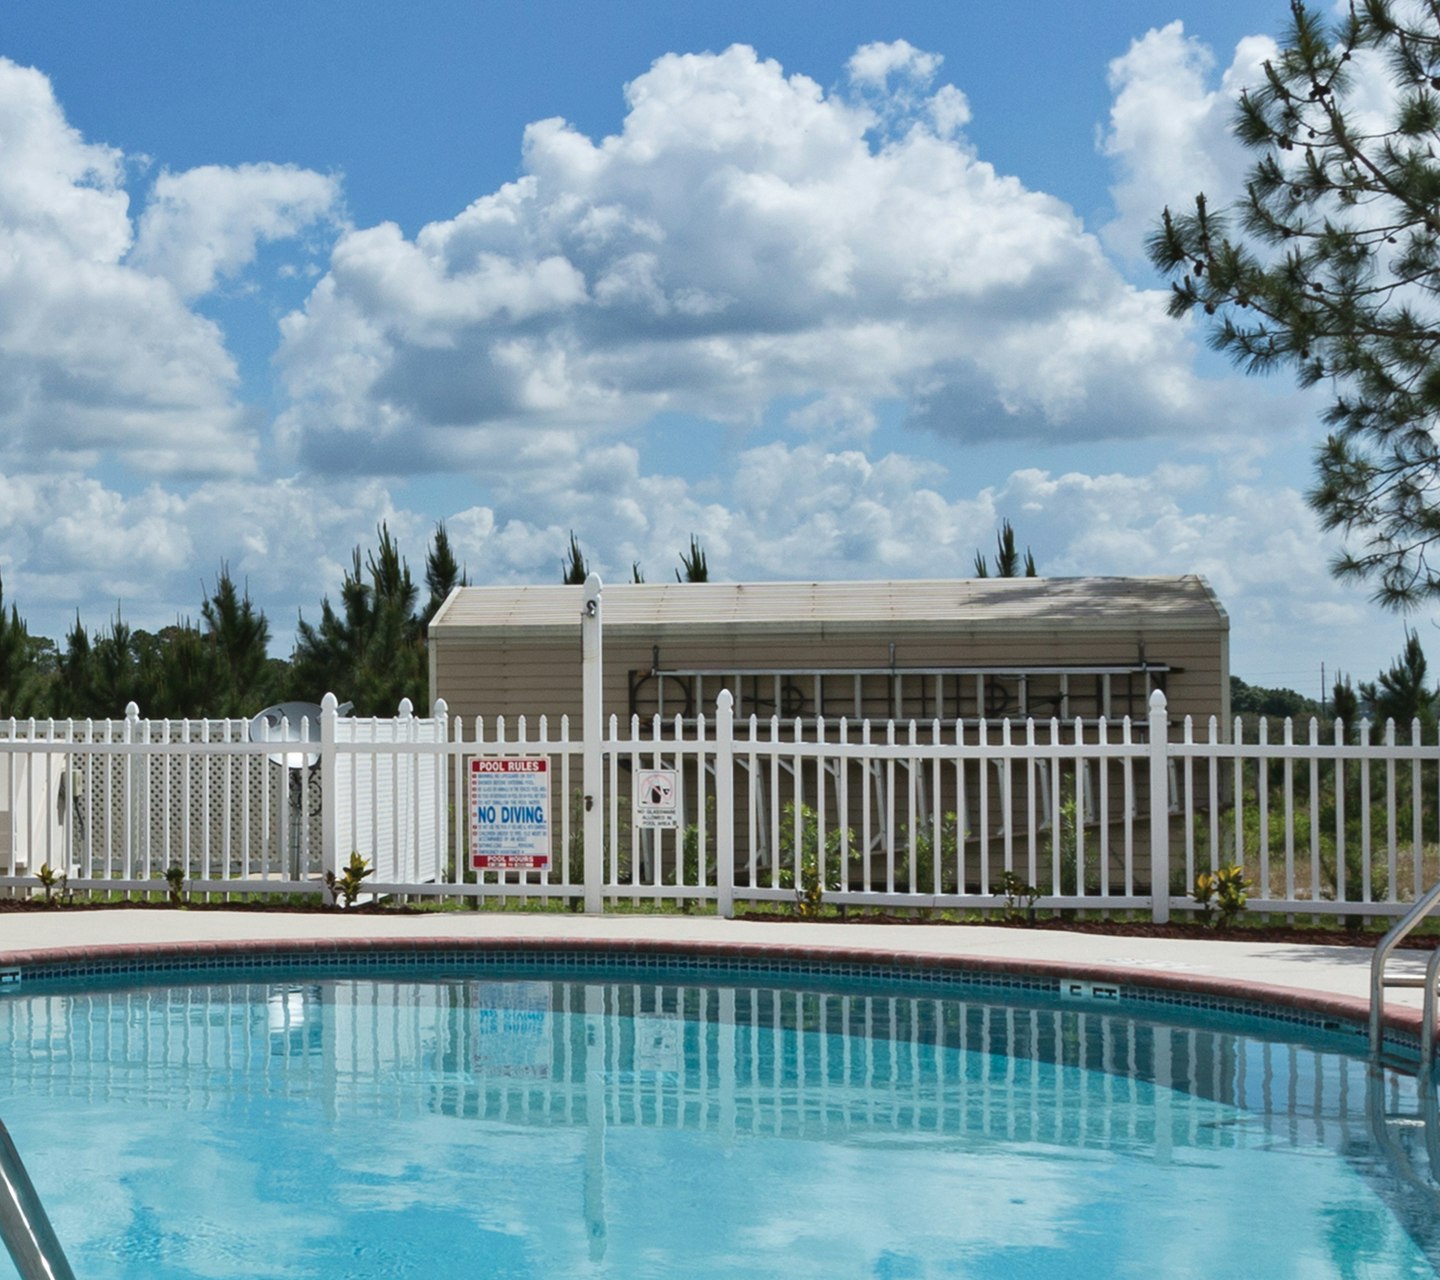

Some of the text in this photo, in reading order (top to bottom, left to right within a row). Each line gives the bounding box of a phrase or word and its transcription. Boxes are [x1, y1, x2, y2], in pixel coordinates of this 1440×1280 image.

[479, 761, 539, 771] POOL RULES
[478, 806, 547, 823] NO DIVING.
